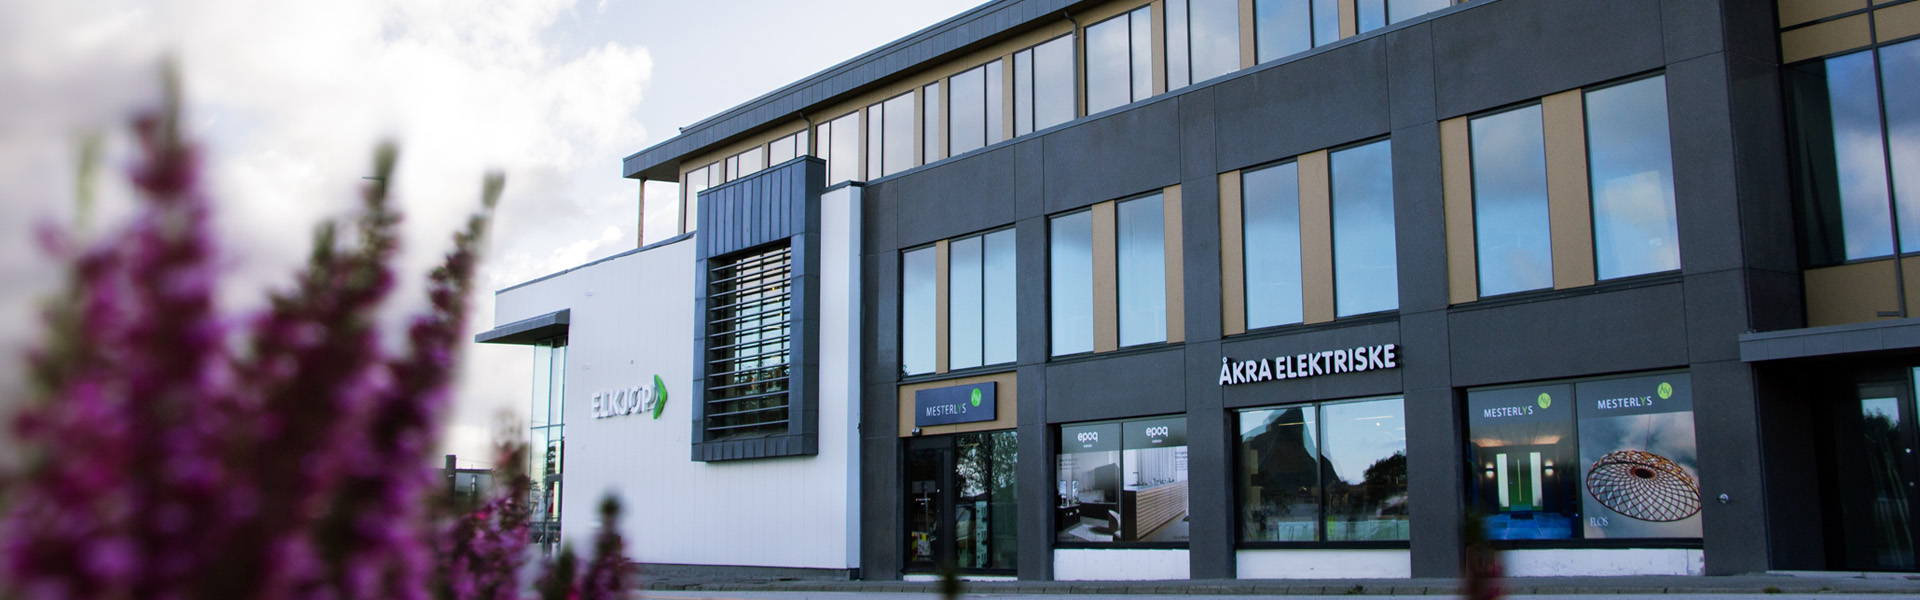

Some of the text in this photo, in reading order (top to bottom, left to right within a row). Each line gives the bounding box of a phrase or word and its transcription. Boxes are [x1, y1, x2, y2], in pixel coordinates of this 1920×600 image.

[1219, 343, 1396, 385] ÅKRA ELEKTRISKE
[591, 384, 656, 419] ELKJØP
[1597, 395, 1653, 410] MESTERLYS
[925, 402, 967, 417] MESTERLYS
[1483, 405, 1534, 418] MESTERLYS
[1077, 431, 1099, 443] epoq
[1145, 425, 1169, 438] epoq
